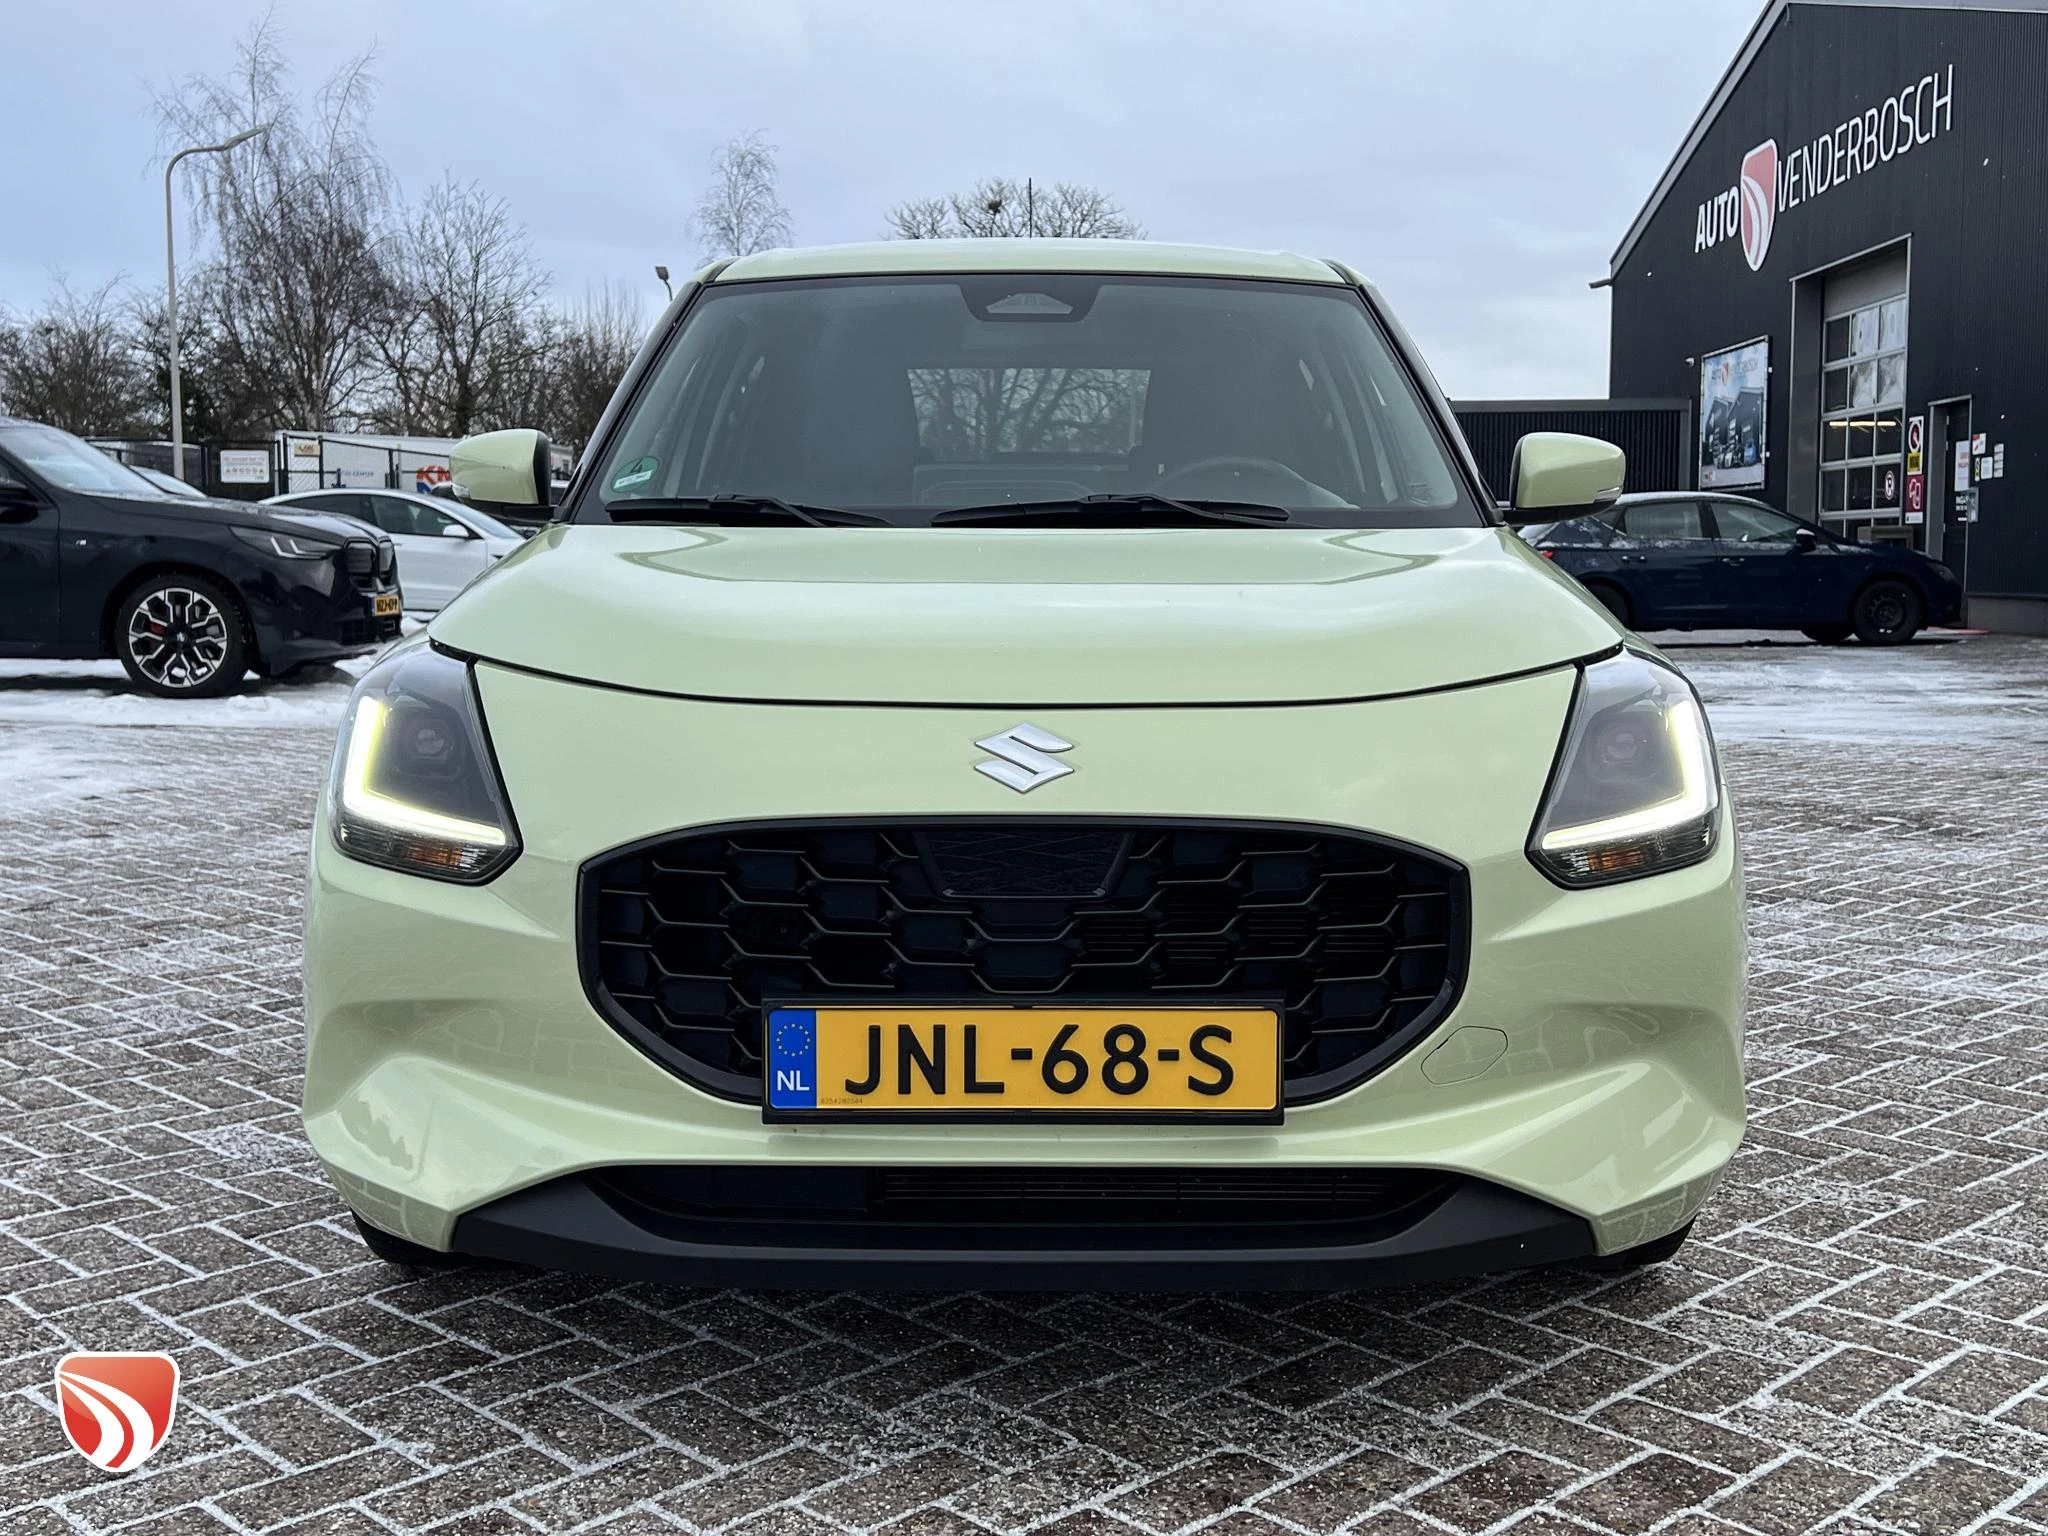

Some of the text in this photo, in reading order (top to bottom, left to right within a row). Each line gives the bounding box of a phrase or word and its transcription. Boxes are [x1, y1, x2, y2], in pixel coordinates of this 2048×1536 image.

[1695, 63, 1953, 253] AUTO VENDERBOSCH
[629, 457, 643, 473] 4
[777, 1069, 810, 1091] NL
[845, 1024, 1234, 1095] JNL-68-S
